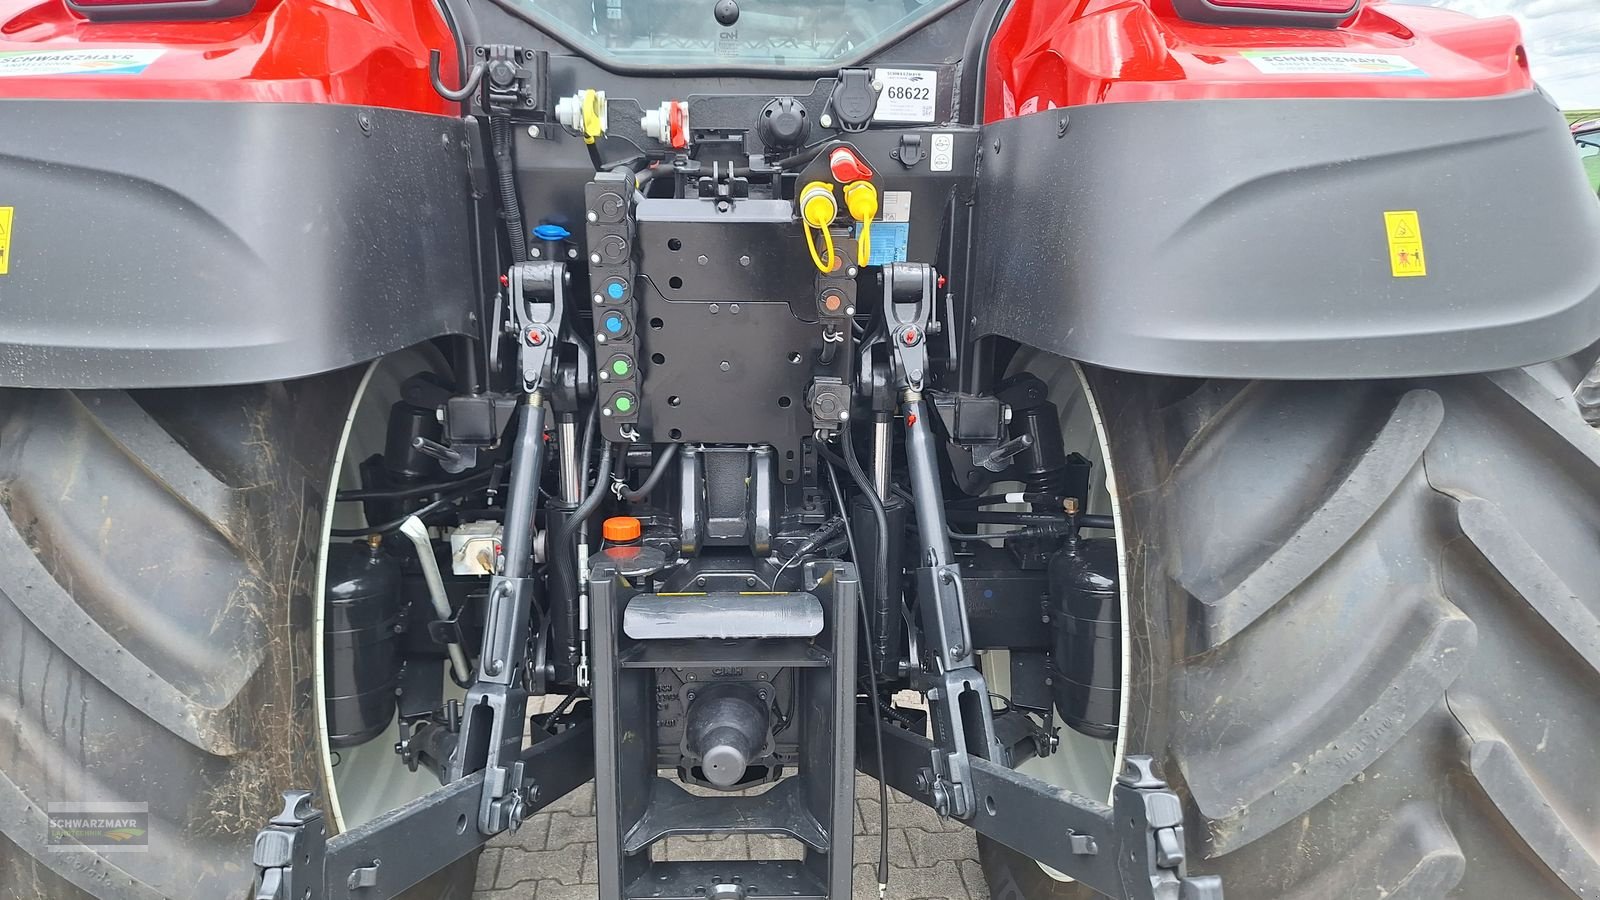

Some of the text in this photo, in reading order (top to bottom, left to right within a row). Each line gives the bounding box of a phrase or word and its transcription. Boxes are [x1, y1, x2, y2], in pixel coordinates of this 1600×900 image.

[720, 30, 738, 39] CNH
[0, 54, 134, 64] SCHWARZMAYR
[1261, 56, 1390, 64] SCHWARZMAYR
[888, 86, 930, 101] 68622
[712, 666, 743, 677] CNH
